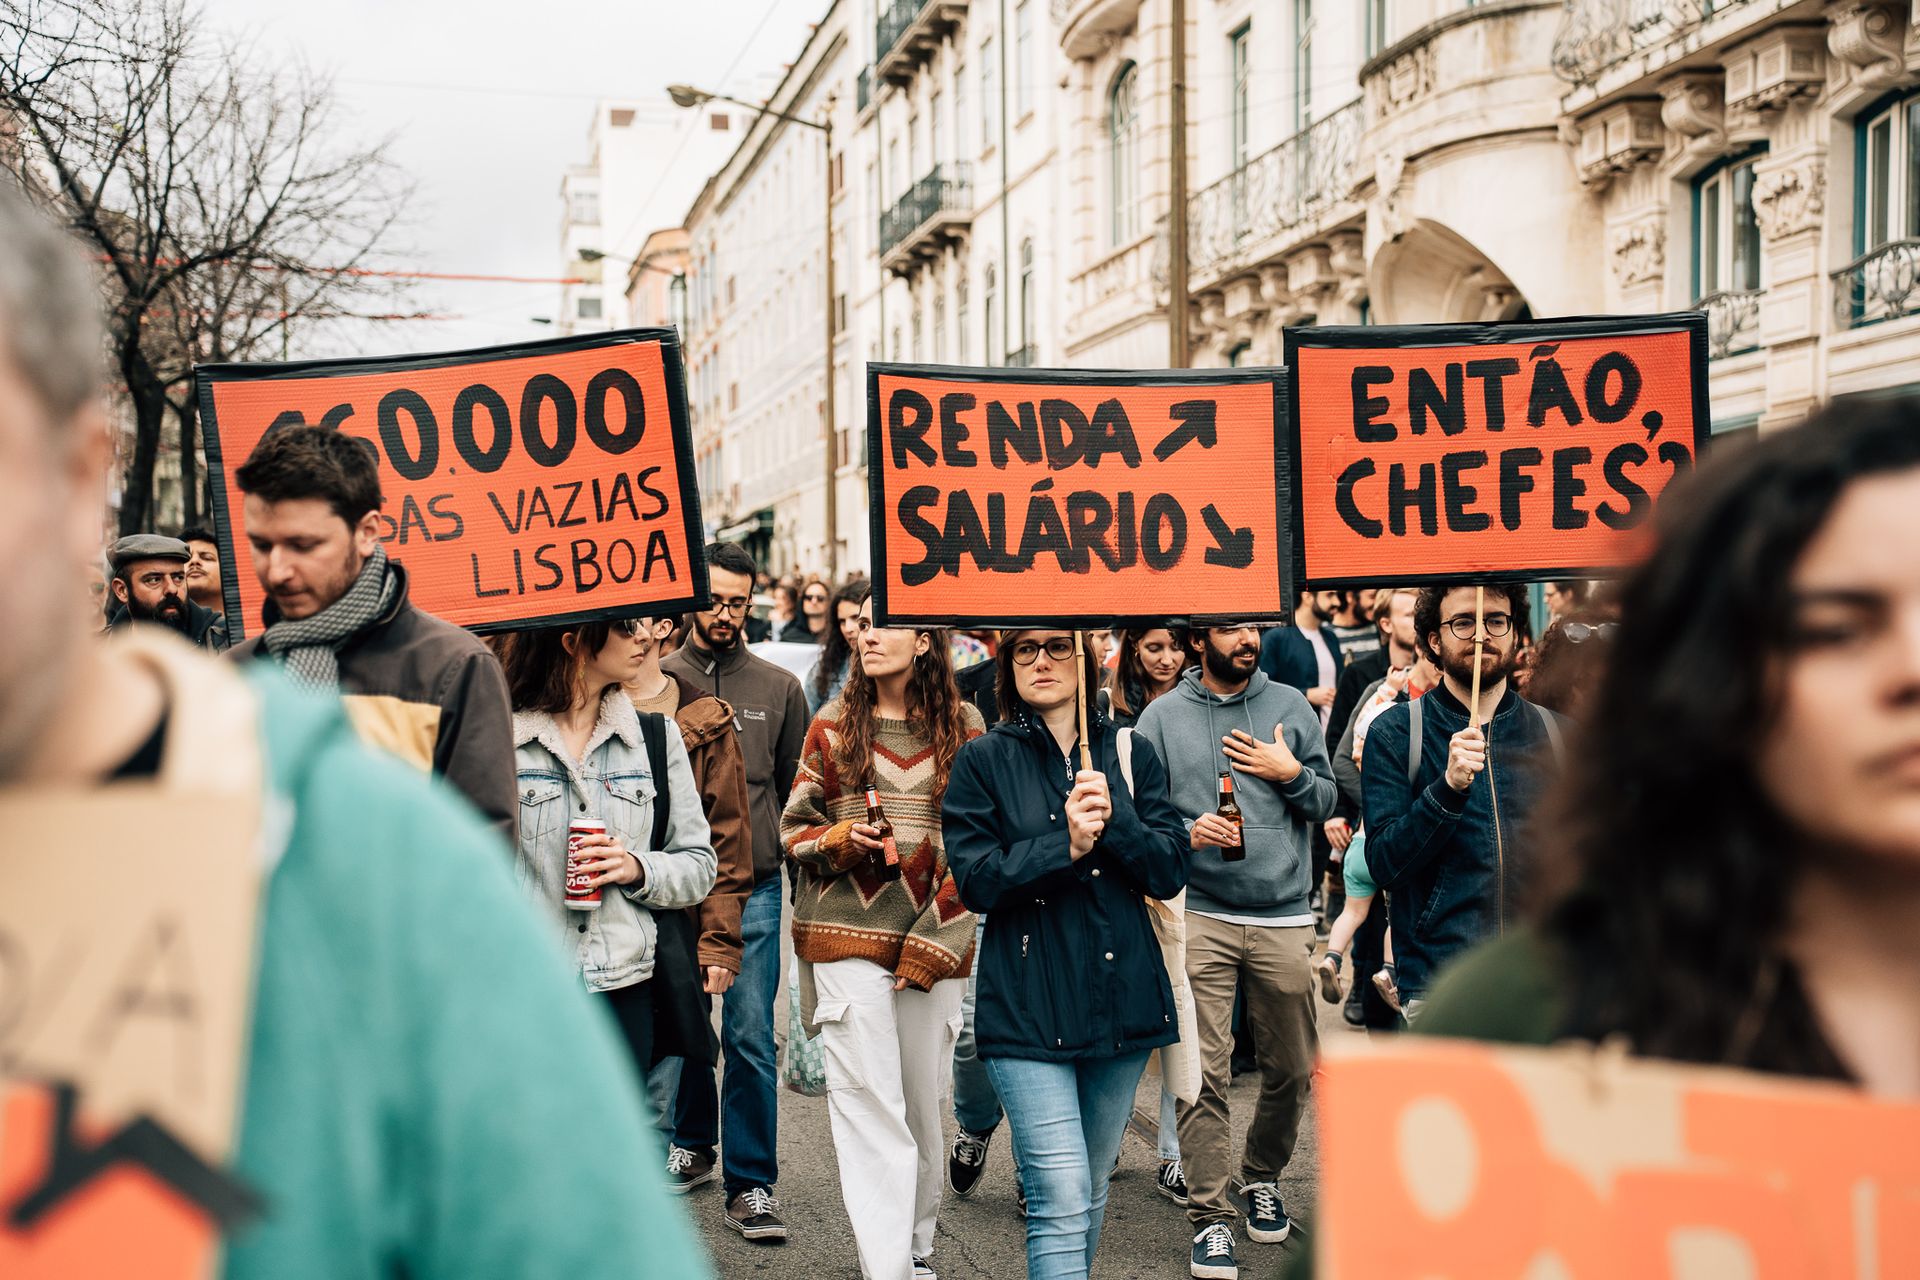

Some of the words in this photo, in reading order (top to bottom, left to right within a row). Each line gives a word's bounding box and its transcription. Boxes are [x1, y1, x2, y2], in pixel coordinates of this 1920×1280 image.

[888, 388, 1142, 471] RENDA
[1351, 343, 1663, 442] ENTÃO,
[488, 466, 670, 535] VAZIAS
[898, 477, 1188, 586] SALÁRIO
[471, 530, 677, 598] LISBOA
[566, 841, 581, 887] SUPER
